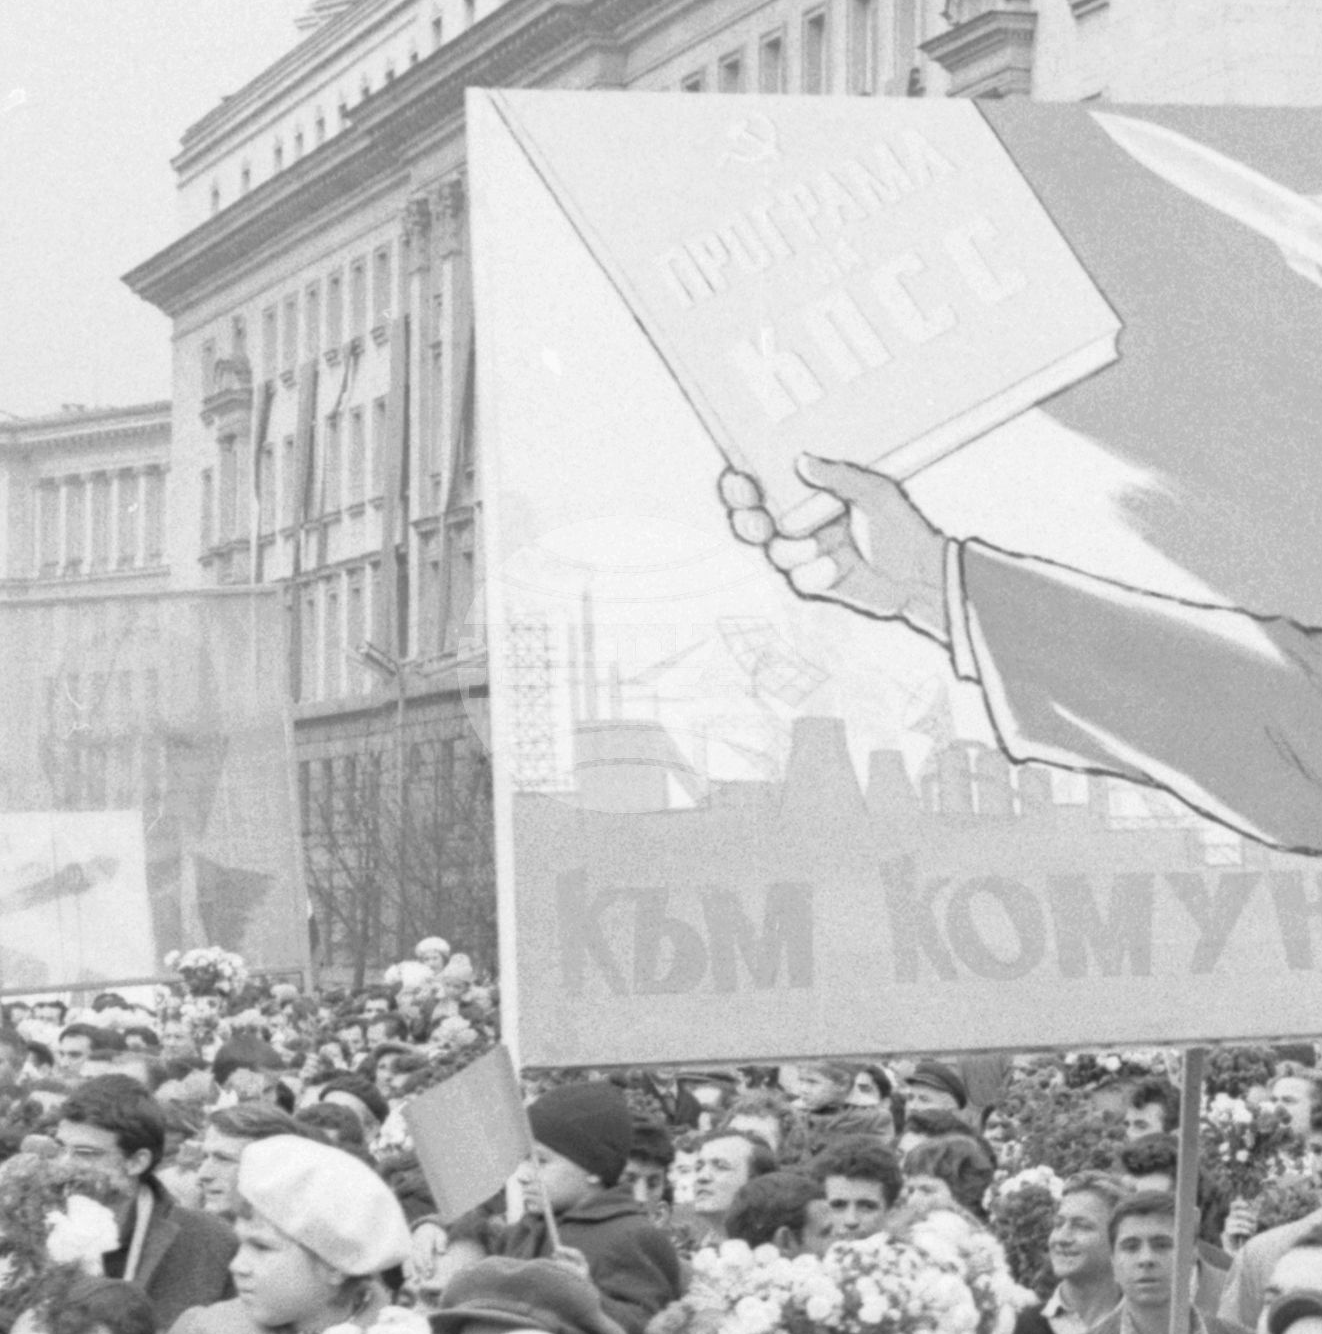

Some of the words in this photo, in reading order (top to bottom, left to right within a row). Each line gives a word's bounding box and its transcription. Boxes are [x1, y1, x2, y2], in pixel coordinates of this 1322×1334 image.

[654, 128, 959, 310] ПРОГРАМА
[726, 215, 1028, 422] КПСС
[555, 868, 814, 996] КЪМ
